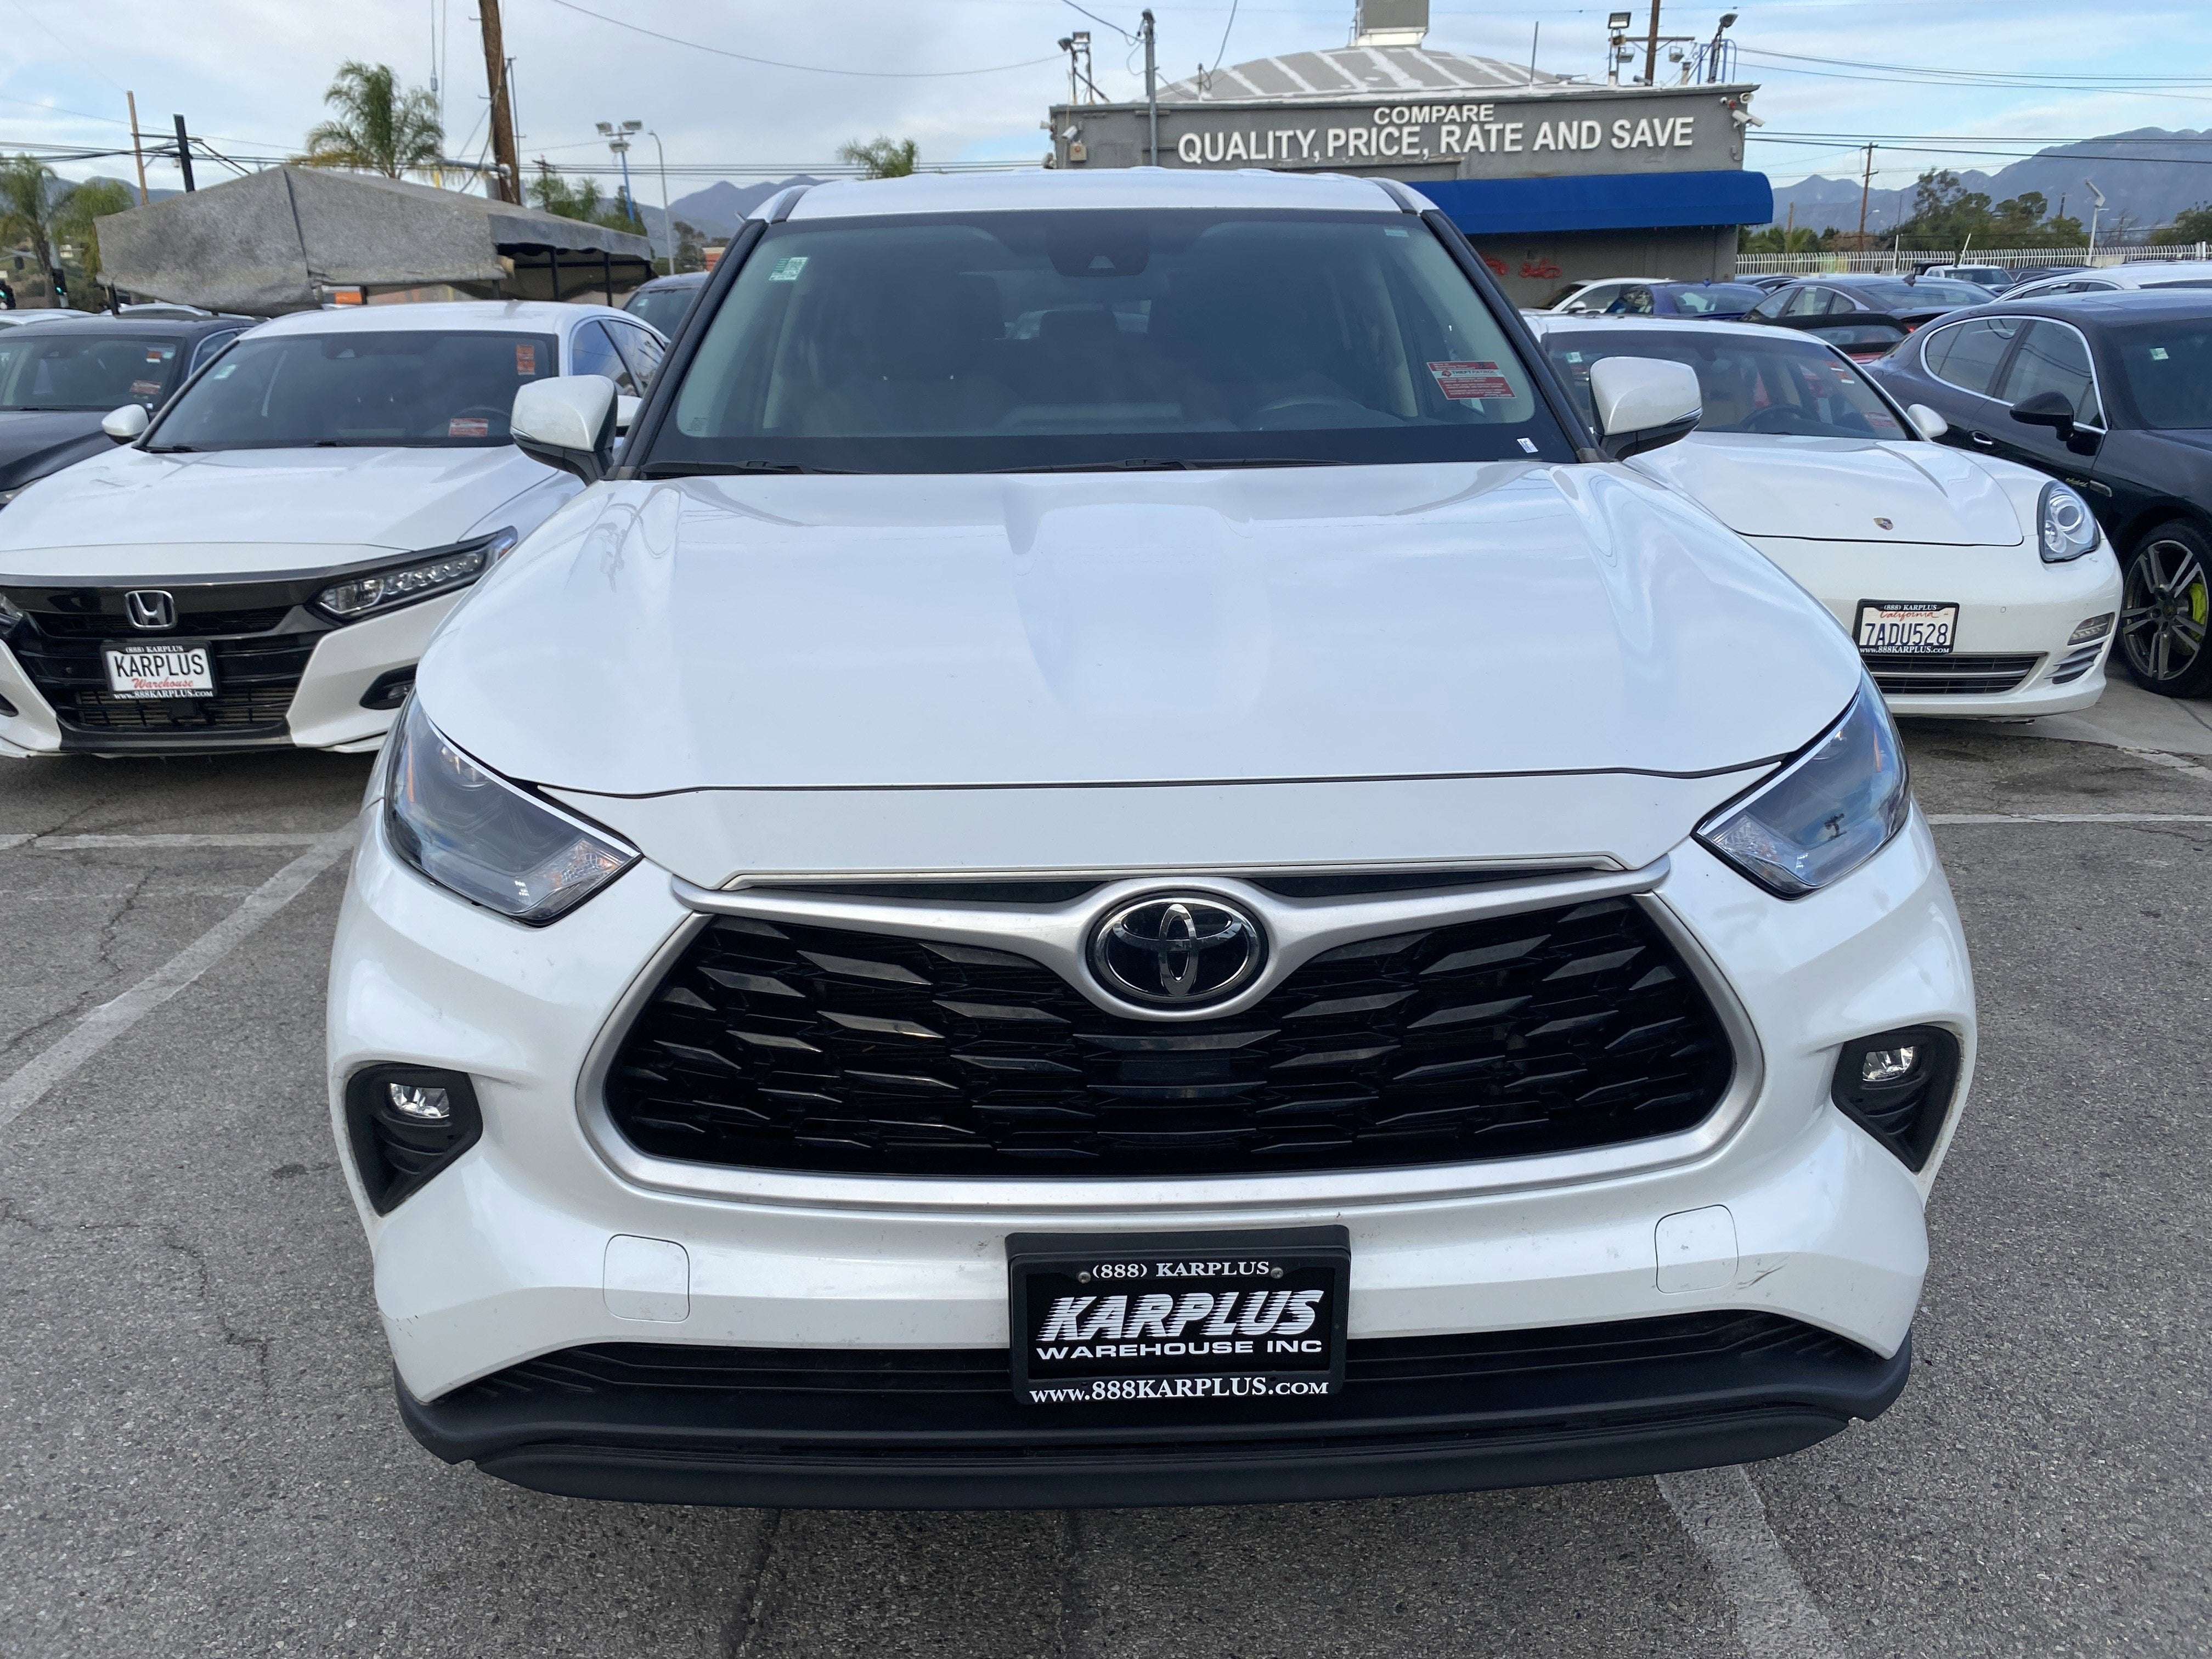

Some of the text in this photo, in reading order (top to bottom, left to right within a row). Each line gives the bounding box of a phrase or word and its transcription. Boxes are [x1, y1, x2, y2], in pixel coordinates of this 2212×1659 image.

[1373, 104, 1494, 125] COMPARE
[1178, 117, 1694, 165] QUALITY, PRICE, RATE AND SAVE
[1880, 611, 1939, 622] California
[1865, 623, 1948, 646] 7ADU528
[114, 653, 204, 677] KARPLUS
[132, 676, 194, 689] Warehouse
[1093, 1261, 1270, 1279] (888) KARPLUS
[1036, 1290, 1324, 1341] KARPLUS
[1036, 1340, 1322, 1360] WAREHOUSE INC
